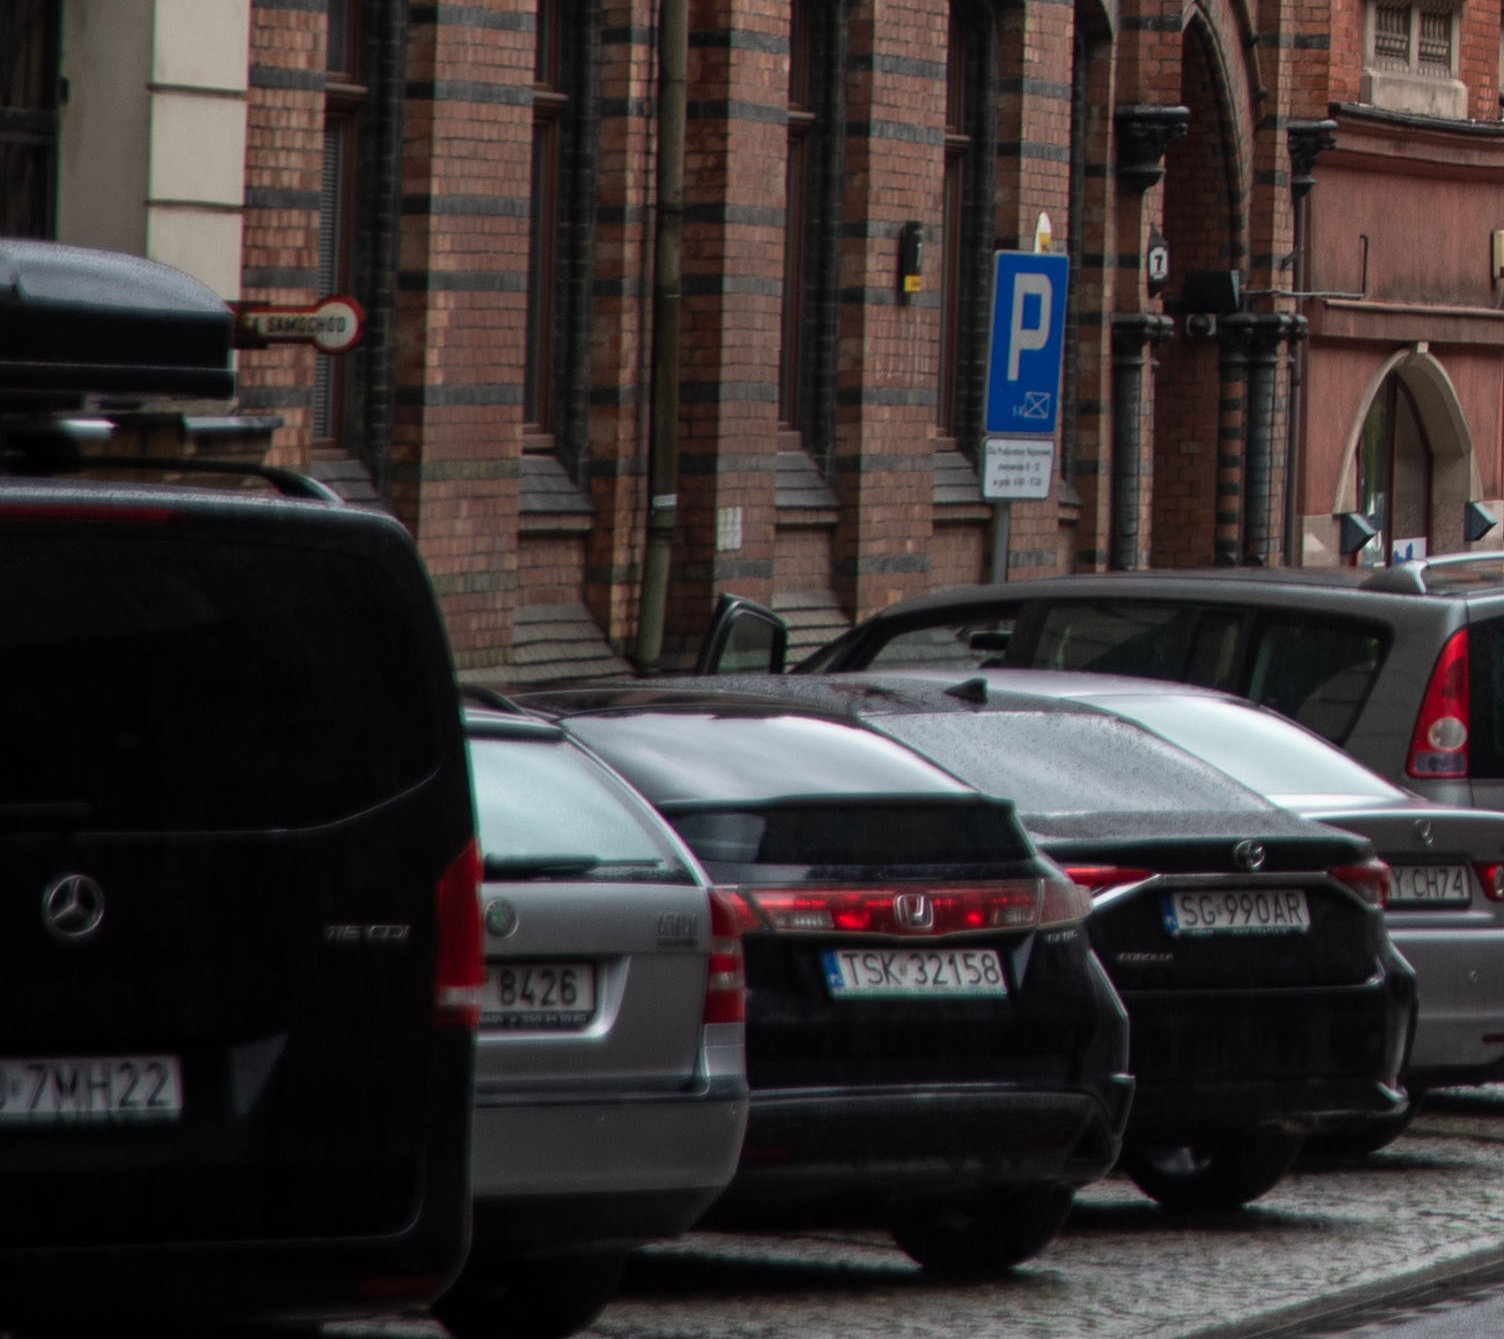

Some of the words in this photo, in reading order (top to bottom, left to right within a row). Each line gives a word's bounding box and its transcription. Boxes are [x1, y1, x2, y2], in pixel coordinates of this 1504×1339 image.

[1154, 255, 1164, 267] 7
[1007, 272, 1053, 383] P
[1412, 866, 1465, 898] CH74
[1180, 890, 1215, 925] SG
[1224, 889, 1303, 926] 990AR
[842, 951, 902, 987] TSK
[909, 951, 1001, 987] 32158
[500, 968, 579, 1007] 8426
